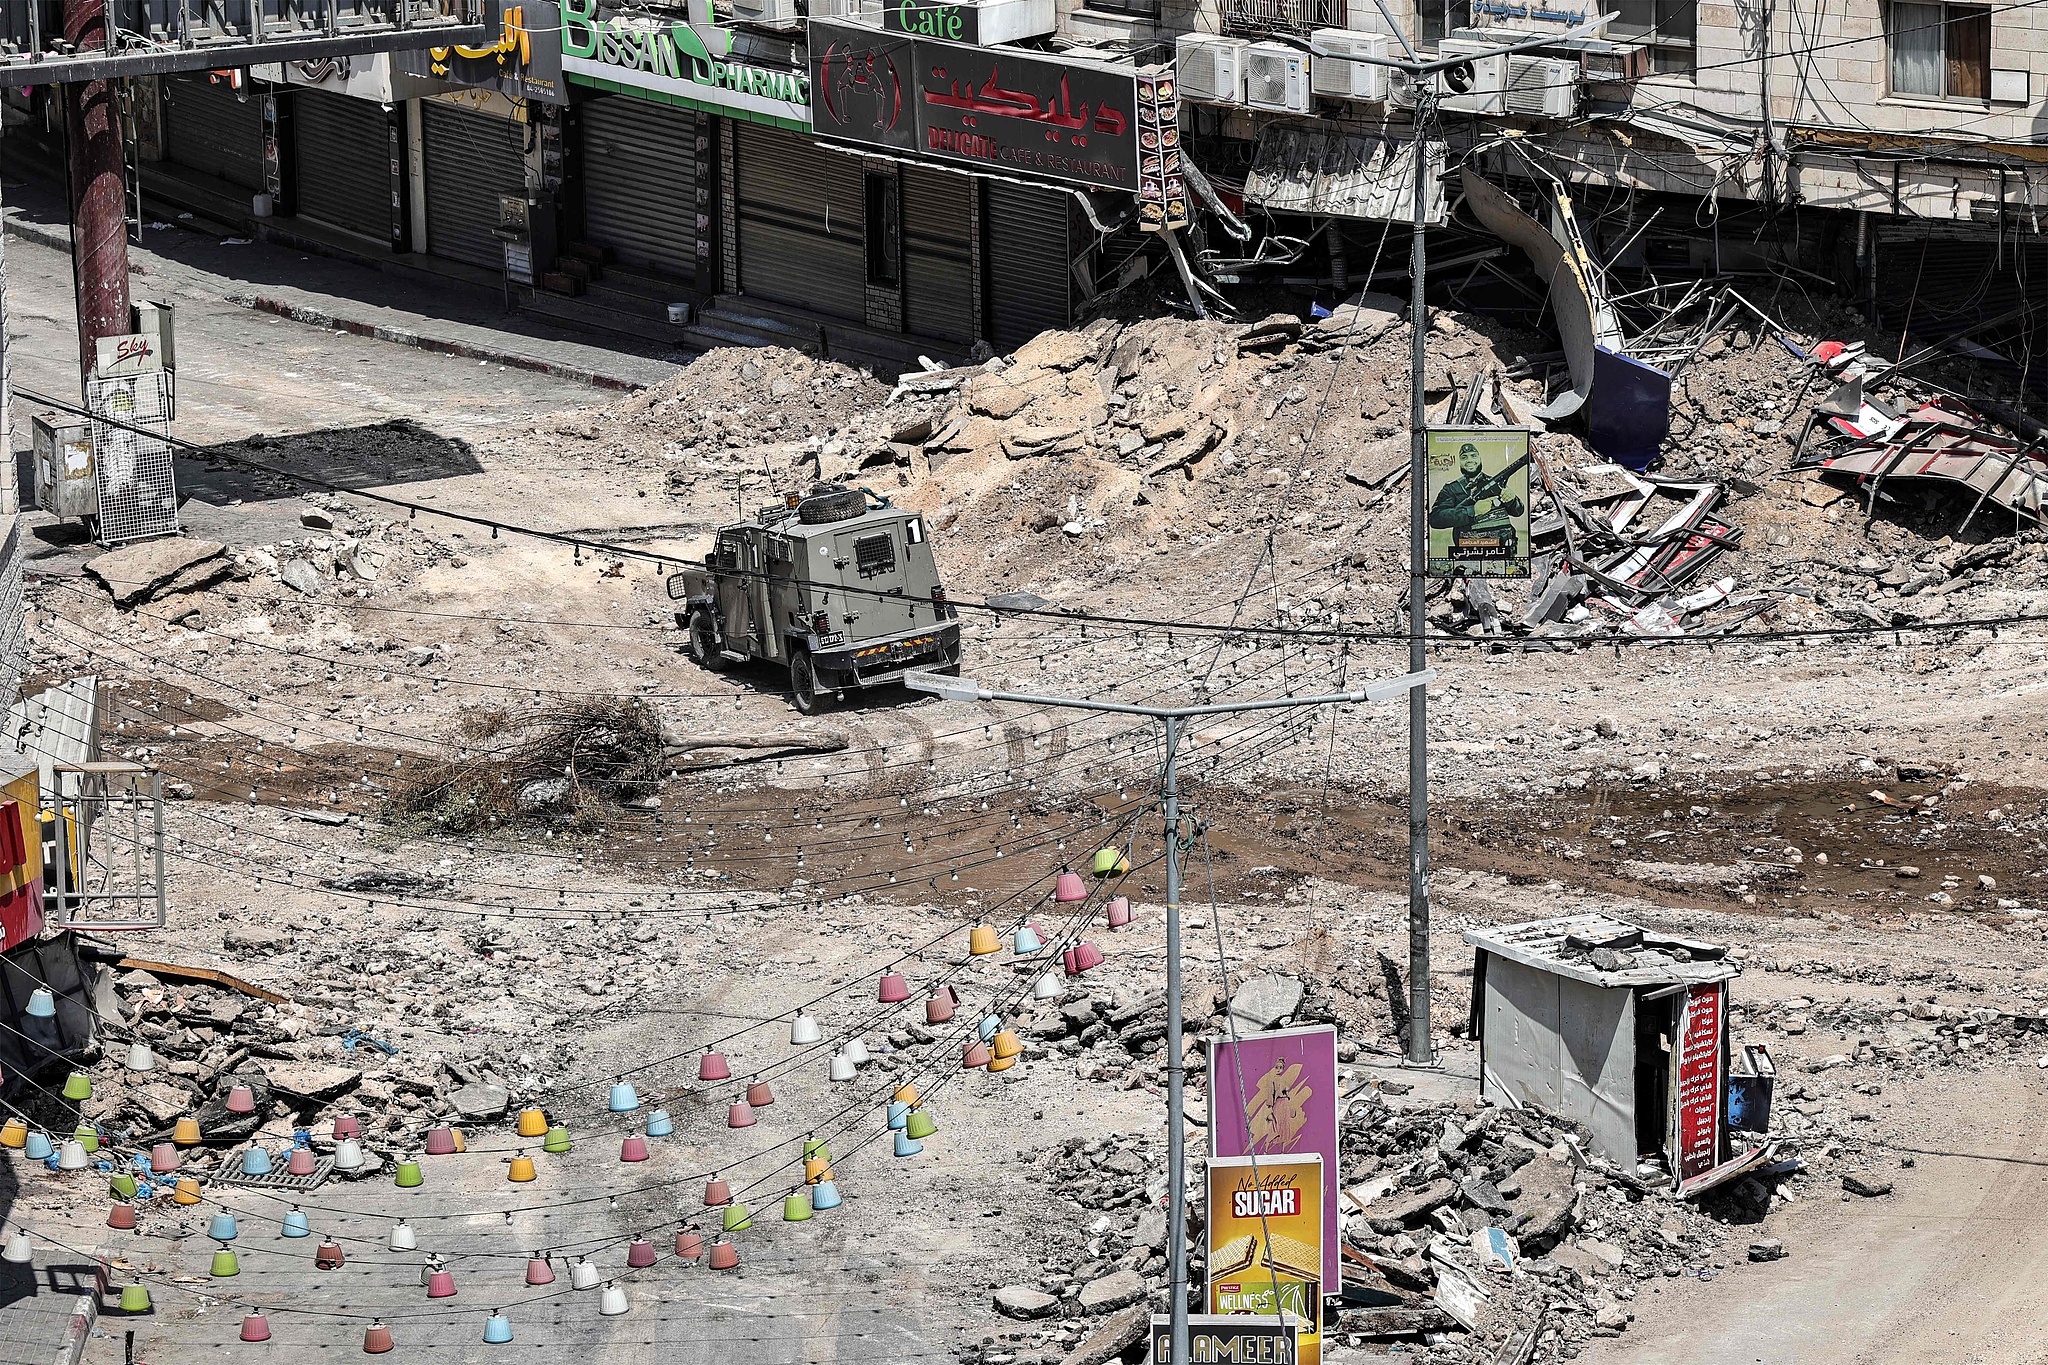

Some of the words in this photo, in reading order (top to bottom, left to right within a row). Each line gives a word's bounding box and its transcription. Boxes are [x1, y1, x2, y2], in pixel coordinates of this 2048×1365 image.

[900, 0, 963, 40] Café
[560, 0, 681, 79] BISSAN
[713, 61, 810, 105] PHARMAC
[520, 73, 555, 88] Restaurant
[928, 125, 998, 161] DELICATE
[999, 146, 1031, 166] CAFE
[1035, 152, 1044, 166] &
[1048, 154, 1127, 182] RESTAURANT
[117, 337, 149, 367] Sky
[908, 518, 921, 544] 1
[1485, 547, 1506, 557] تامر
[1237, 1175, 1255, 1191] No
[1256, 1174, 1298, 1190] Added
[1235, 1189, 1295, 1217] SUGAR
[1219, 1291, 1270, 1309] WELLNESS
[1157, 1334, 1293, 1365] AAMEER
